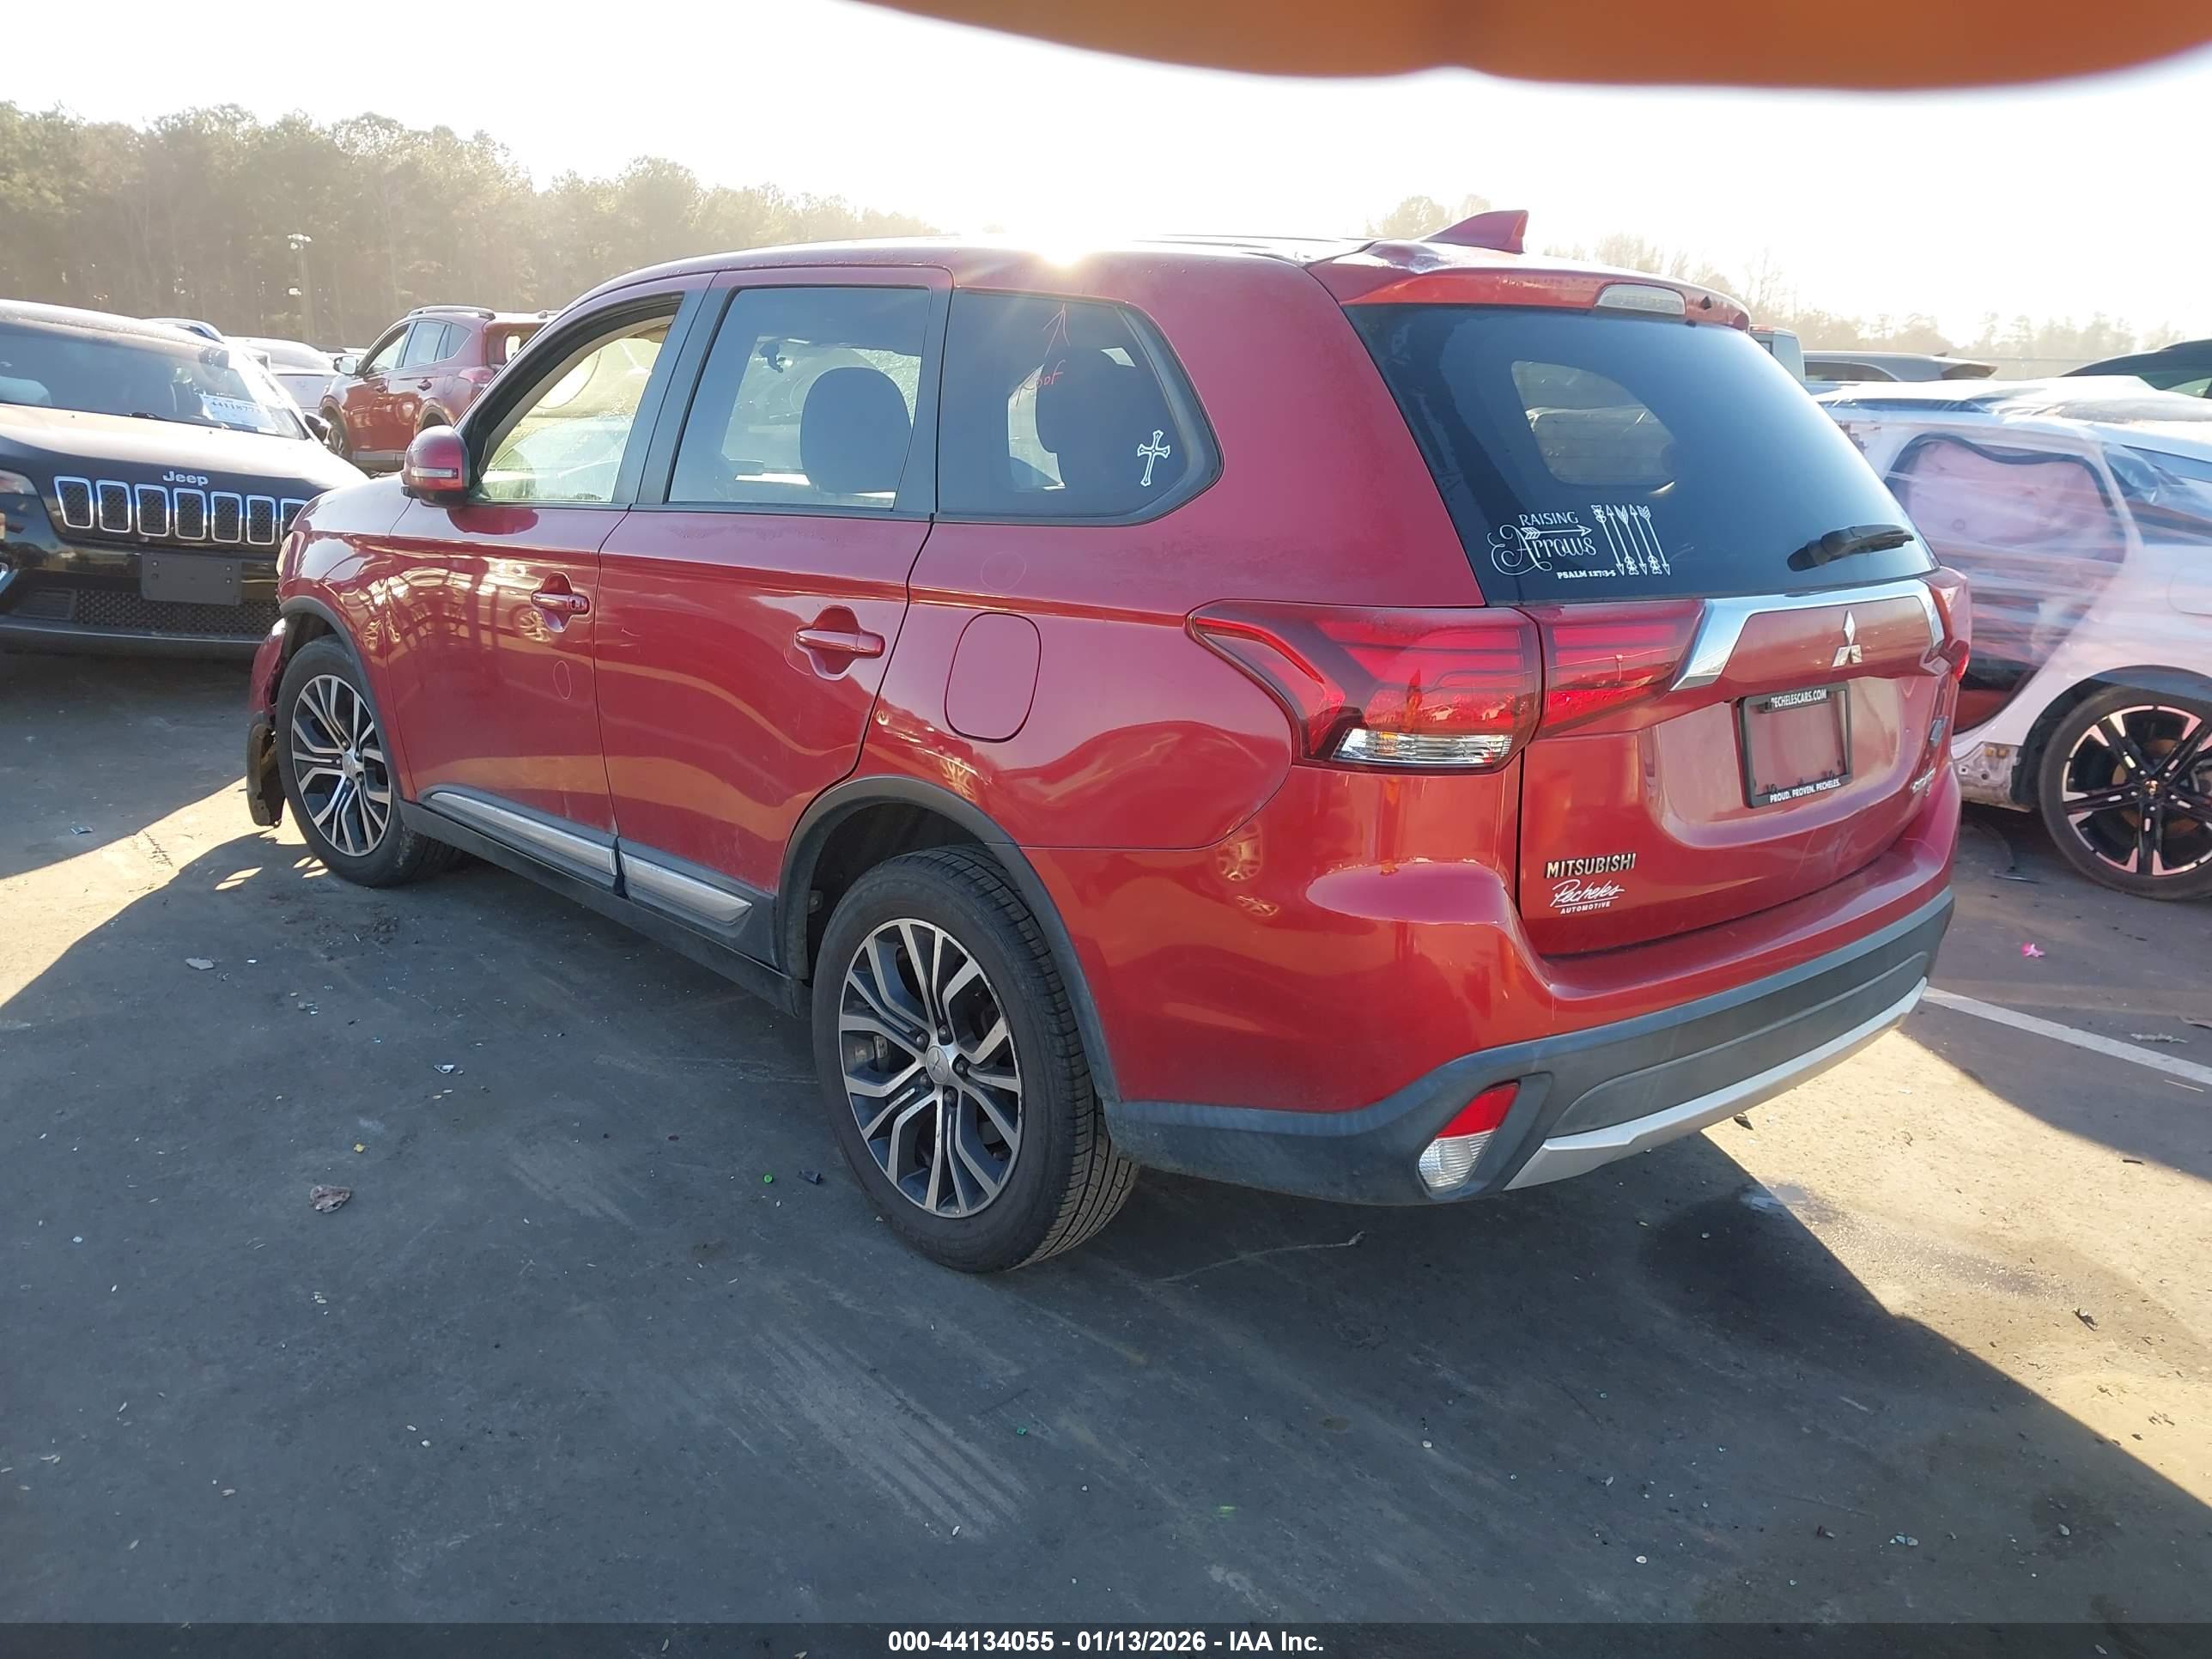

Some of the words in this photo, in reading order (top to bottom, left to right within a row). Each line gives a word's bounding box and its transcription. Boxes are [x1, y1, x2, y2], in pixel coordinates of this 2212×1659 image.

[162, 471, 209, 487] Jeep
[1518, 511, 1578, 526] RAISING
[1486, 524, 1597, 576] Arrows
[1556, 569, 1588, 580] PSALM
[1769, 791, 1792, 804] PROUD.
[1546, 853, 1637, 879] MITSUBISHI
[1550, 878, 1626, 908] Pecheles
[1560, 901, 1612, 915] AUTOMOTIVE
